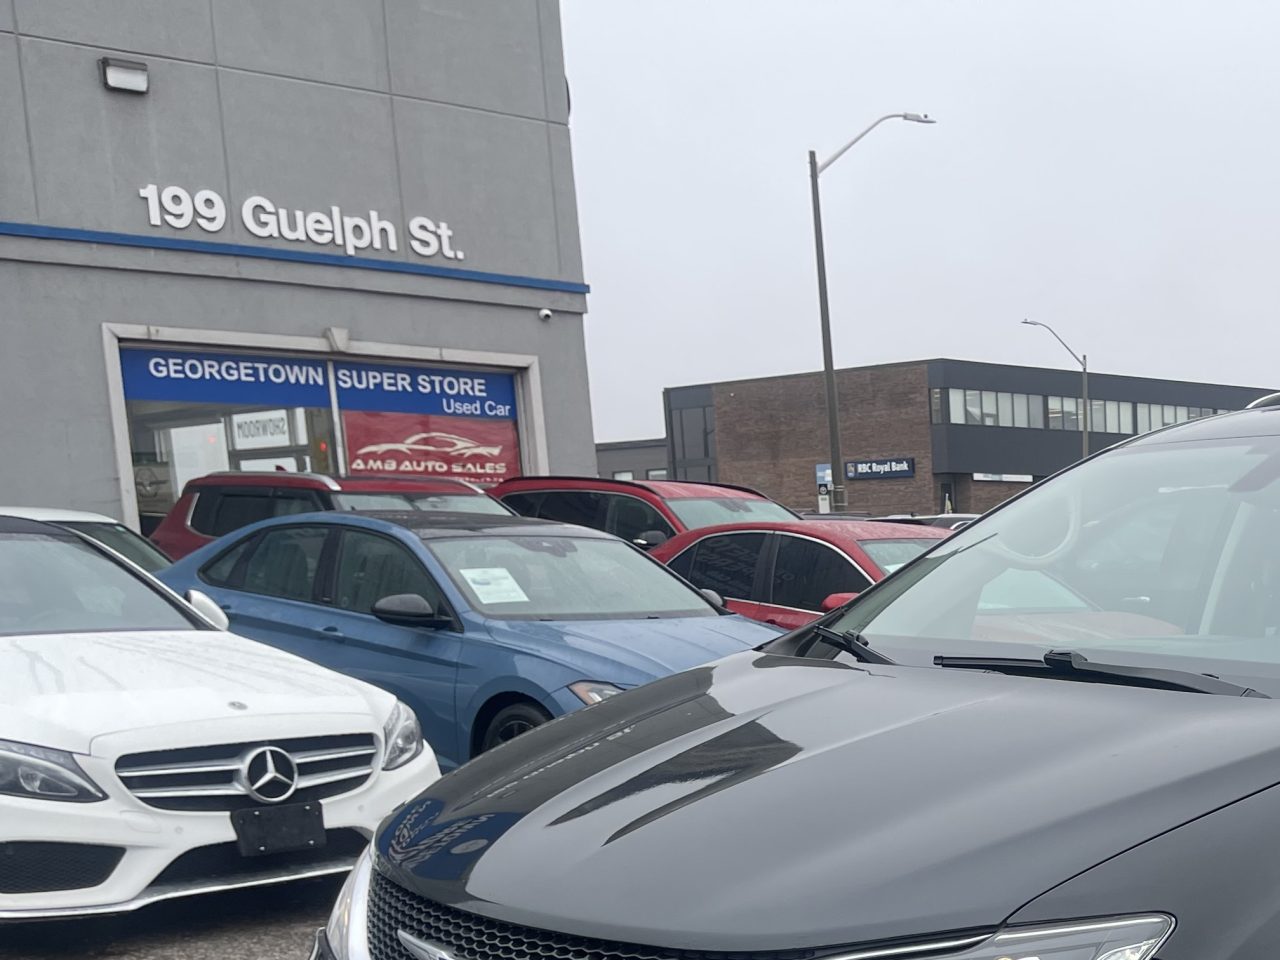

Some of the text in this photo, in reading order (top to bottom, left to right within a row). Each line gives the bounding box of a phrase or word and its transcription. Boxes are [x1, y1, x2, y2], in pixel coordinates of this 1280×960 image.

[139, 184, 464, 260] 199 Guelph St.
[149, 357, 487, 397] GEORGETOWN SUPER STORE
[443, 398, 511, 416] Used Car
[399, 460, 448, 472] AUTO
[452, 462, 506, 474] SALES
[857, 461, 909, 474] RBC Royal Bank
